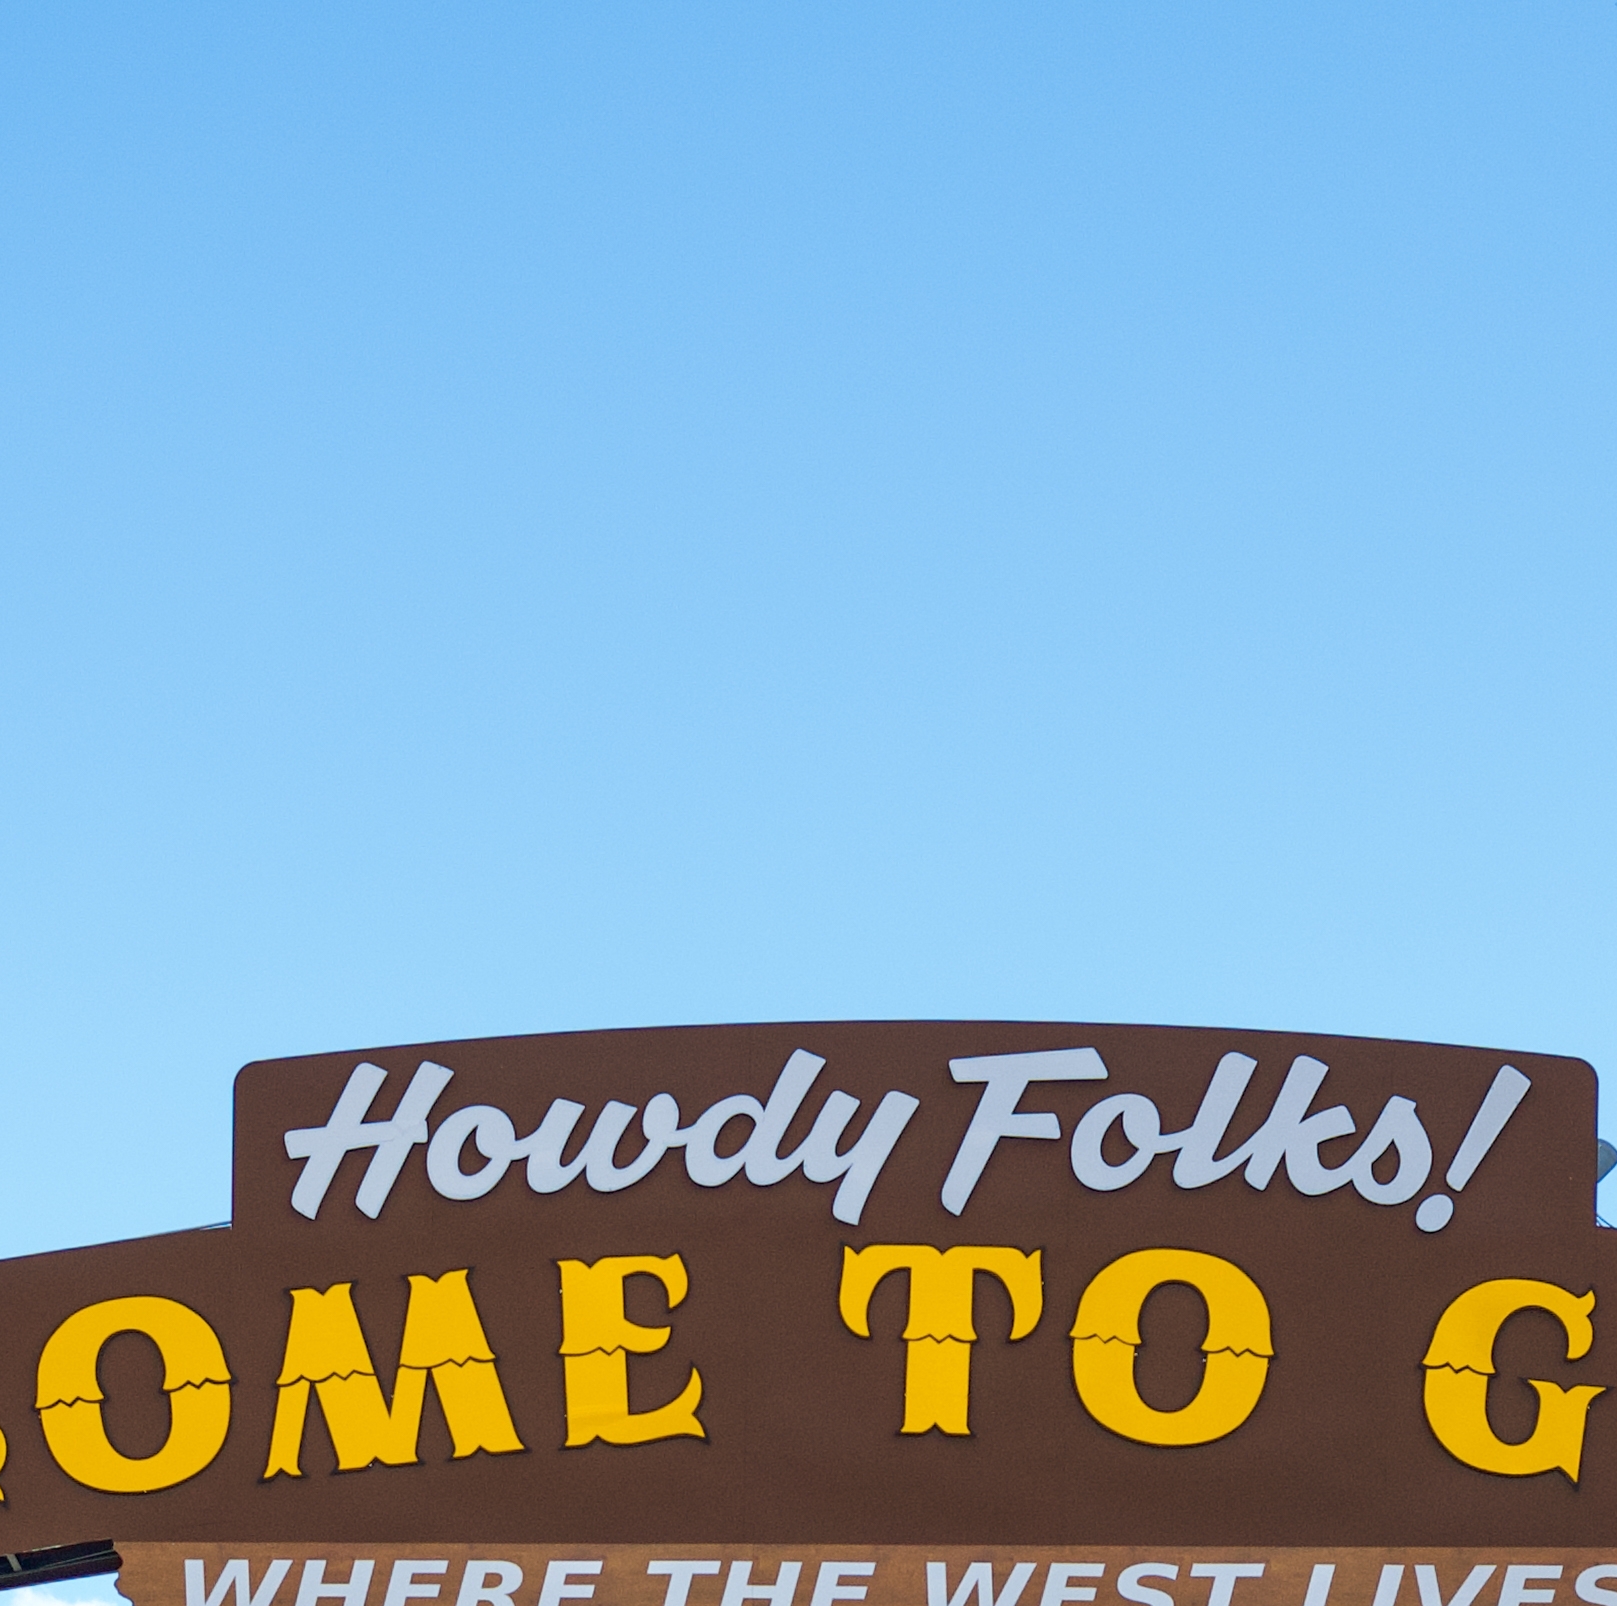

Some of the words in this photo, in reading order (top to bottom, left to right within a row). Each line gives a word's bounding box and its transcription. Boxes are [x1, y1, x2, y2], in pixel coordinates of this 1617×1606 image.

[283, 1048, 921, 1226] Howdy
[941, 1047, 1532, 1232] Folks!
[839, 1244, 1274, 1446] TO
